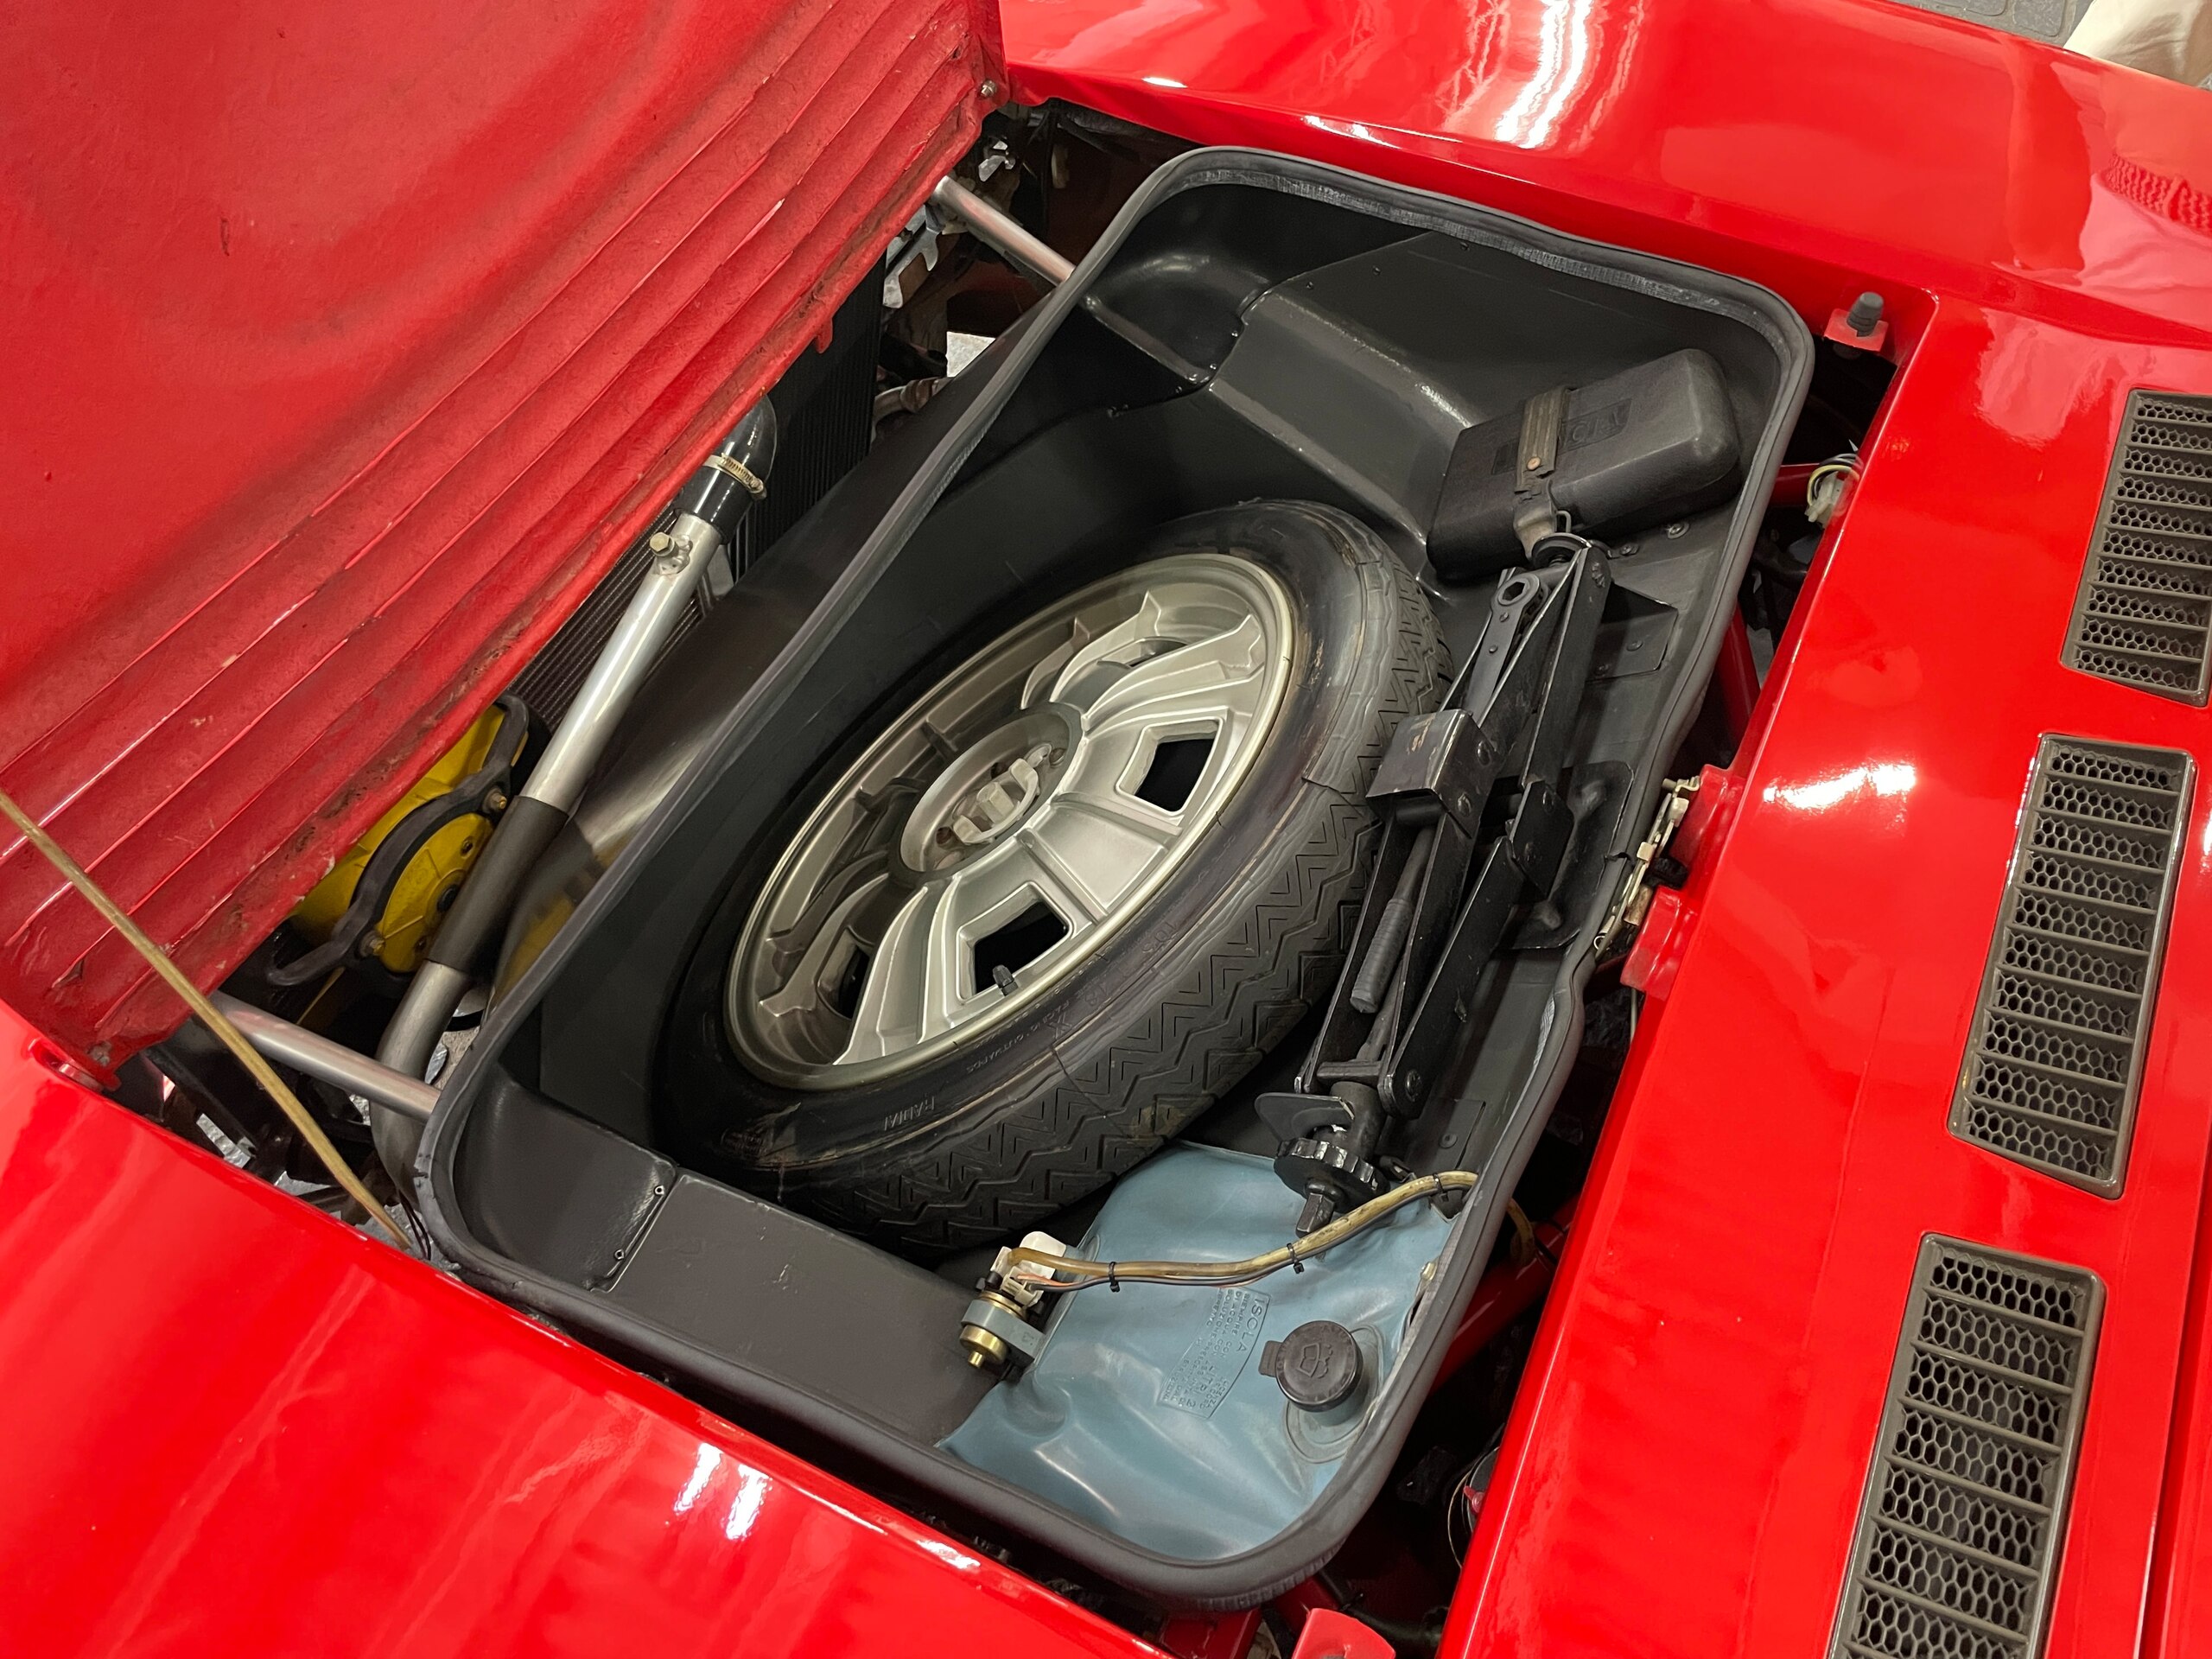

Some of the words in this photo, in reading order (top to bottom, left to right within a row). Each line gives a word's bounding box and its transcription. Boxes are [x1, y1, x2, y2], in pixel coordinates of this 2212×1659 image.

[1210, 1289, 1233, 1338] SOLUZIONE
[1222, 1304, 1237, 1335] ACQUA
[1236, 1297, 1266, 1351] ISOLA
[1211, 1338, 1223, 1356] CON
[1219, 1340, 1232, 1358] CON
[1185, 1399, 1196, 1408] 2
